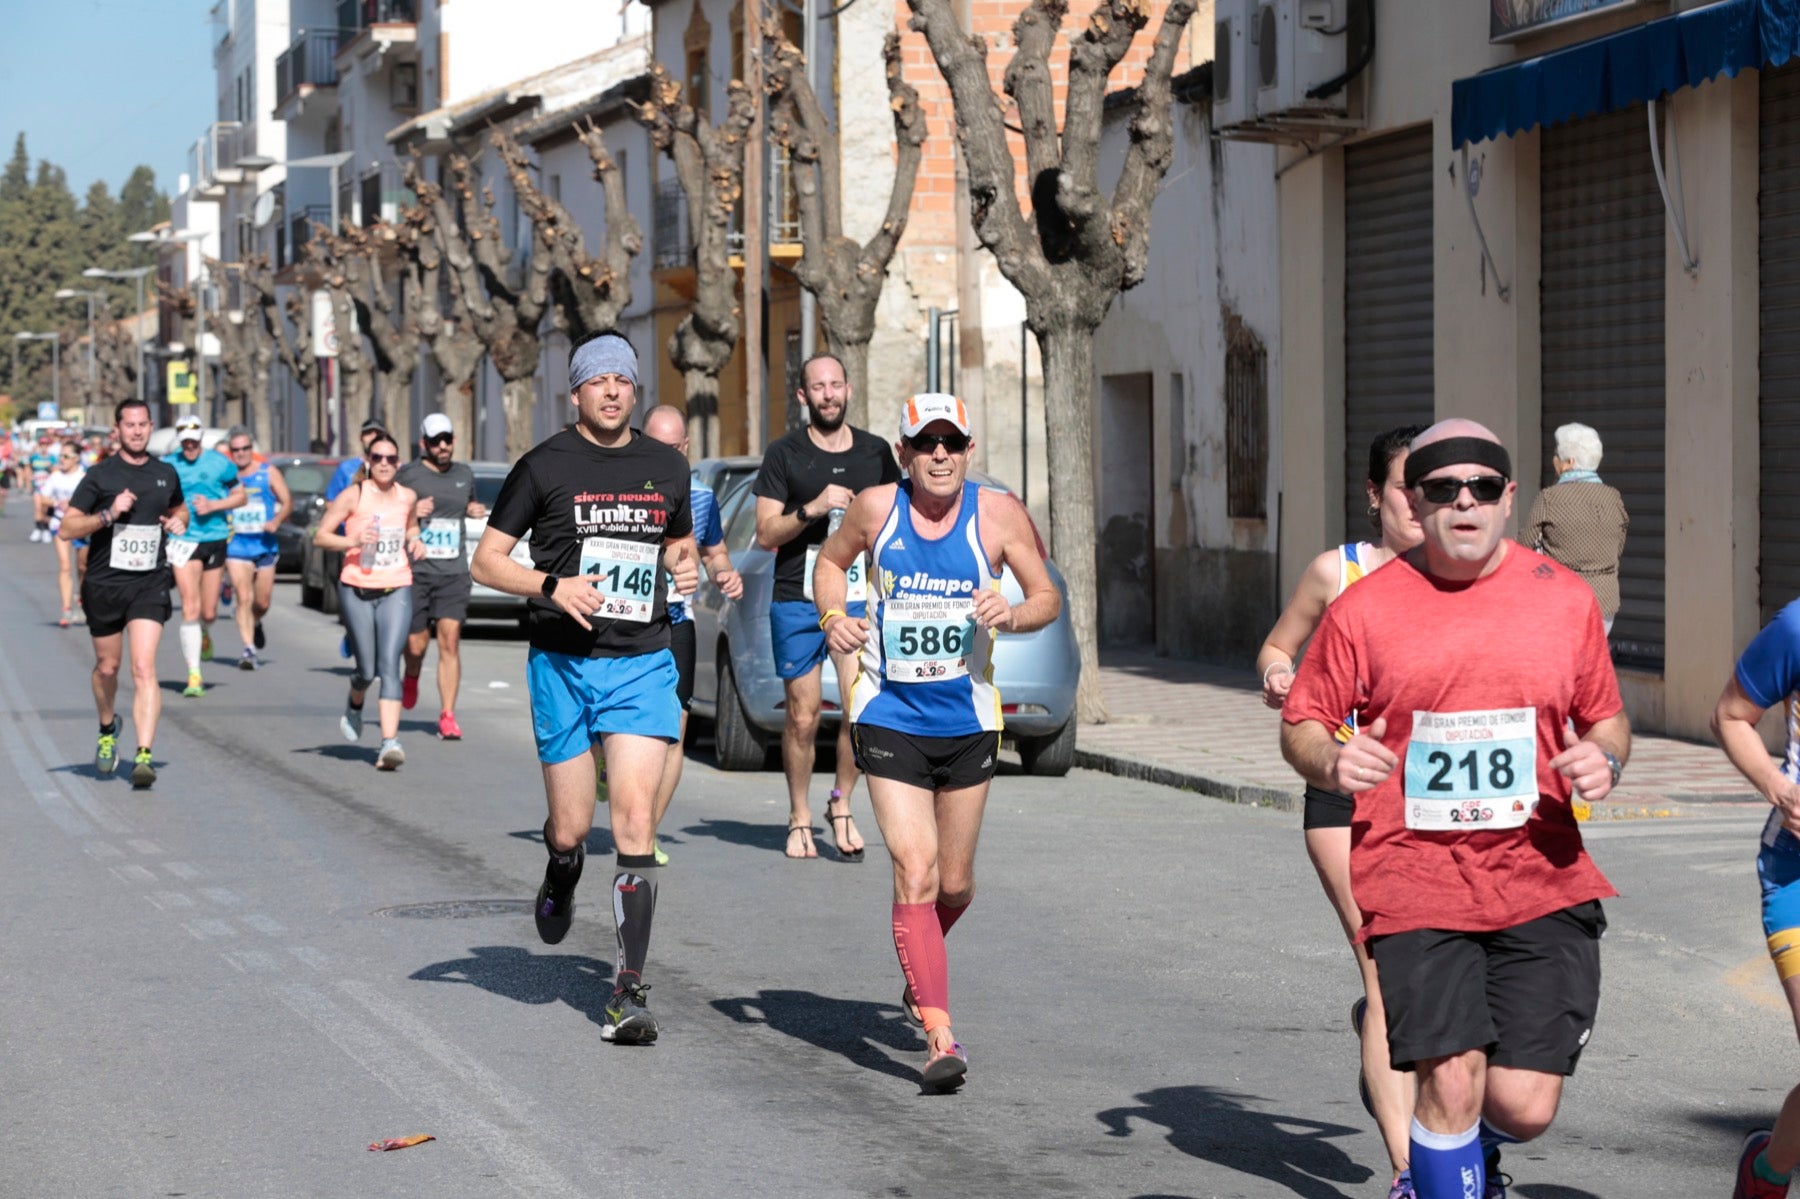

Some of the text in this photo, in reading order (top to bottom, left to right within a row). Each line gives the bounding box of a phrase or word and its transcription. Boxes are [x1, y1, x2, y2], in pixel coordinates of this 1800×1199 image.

[574, 491, 615, 503] sierra
[577, 526, 598, 534] XVIII
[630, 524, 640, 533] al
[425, 532, 453, 545] 211
[119, 538, 157, 554] 3035
[376, 540, 400, 554] 033
[586, 562, 653, 597] 1146
[899, 572, 973, 596] olimpo
[905, 602, 920, 610] GRAN
[921, 602, 942, 610] PREMIO
[943, 601, 951, 609] DE
[912, 610, 947, 620] DIPUTACIÓN
[899, 625, 962, 655] 586
[1457, 714, 1487, 727] PREMIO
[1427, 748, 1514, 791] 218
